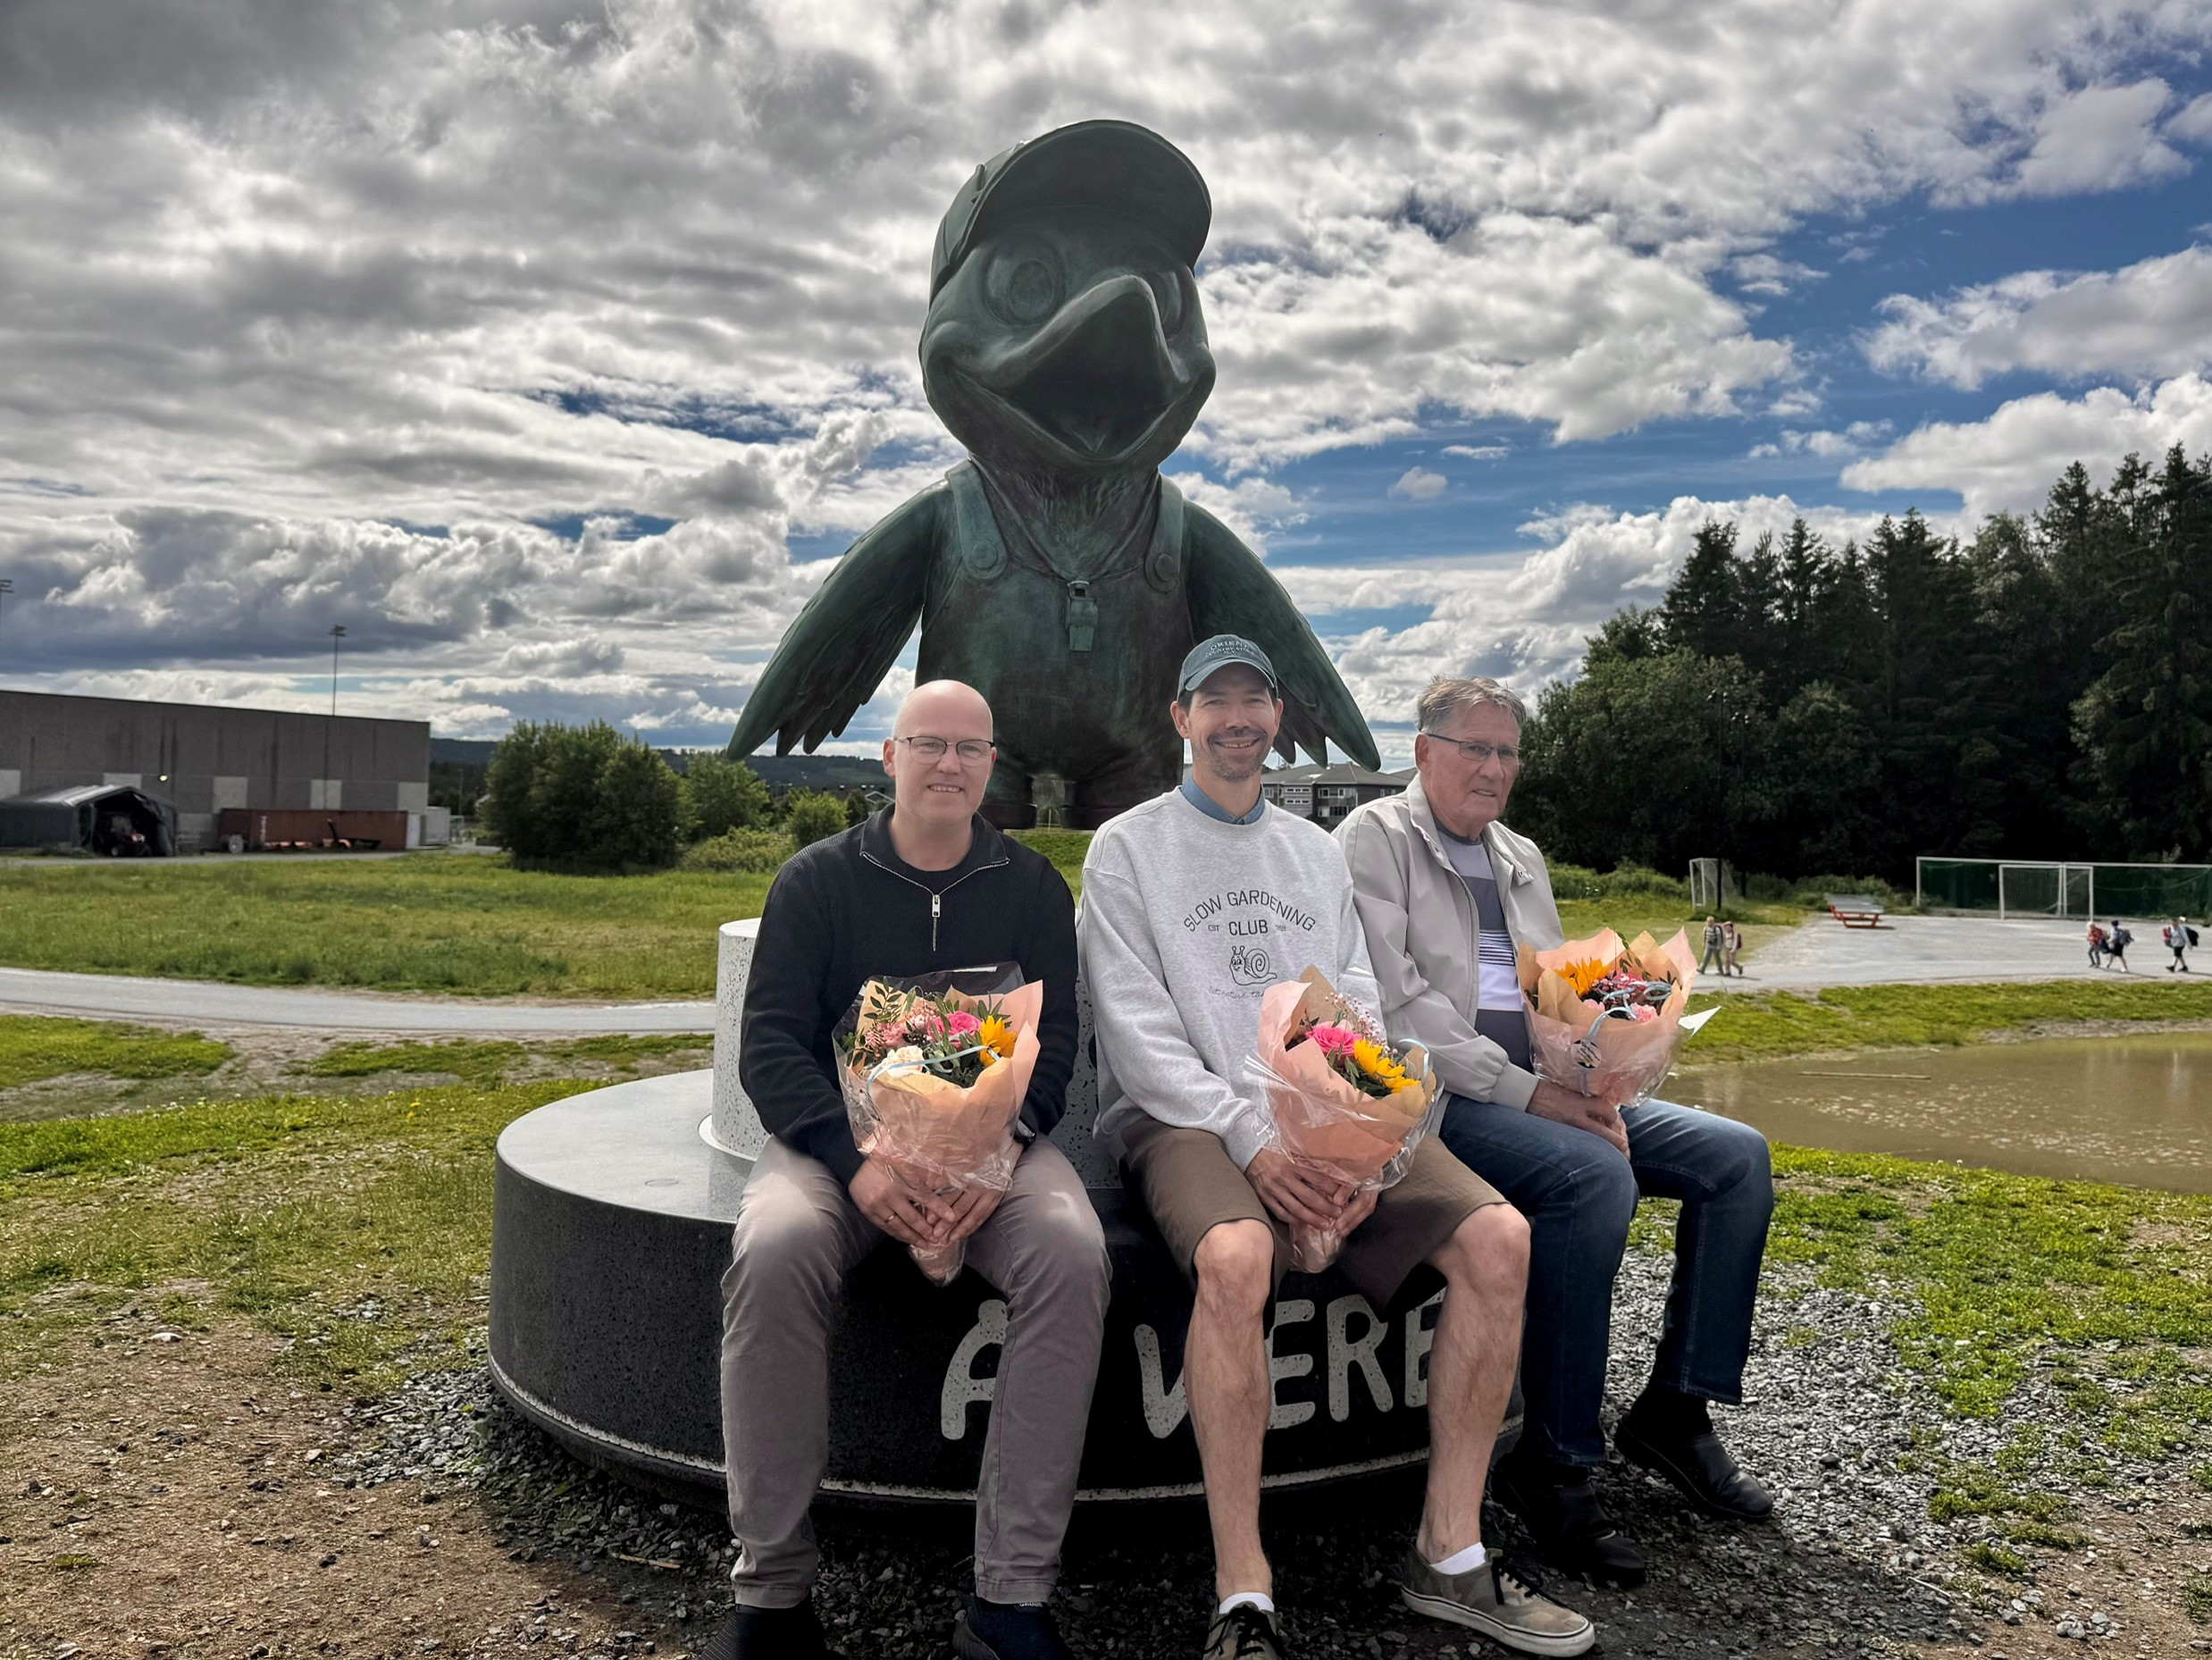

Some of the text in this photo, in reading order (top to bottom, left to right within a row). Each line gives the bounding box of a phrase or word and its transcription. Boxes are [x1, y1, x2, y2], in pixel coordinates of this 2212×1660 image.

[1183, 890, 1316, 932] SLOW GARDENING
[1228, 919, 1269, 936] CLUB
